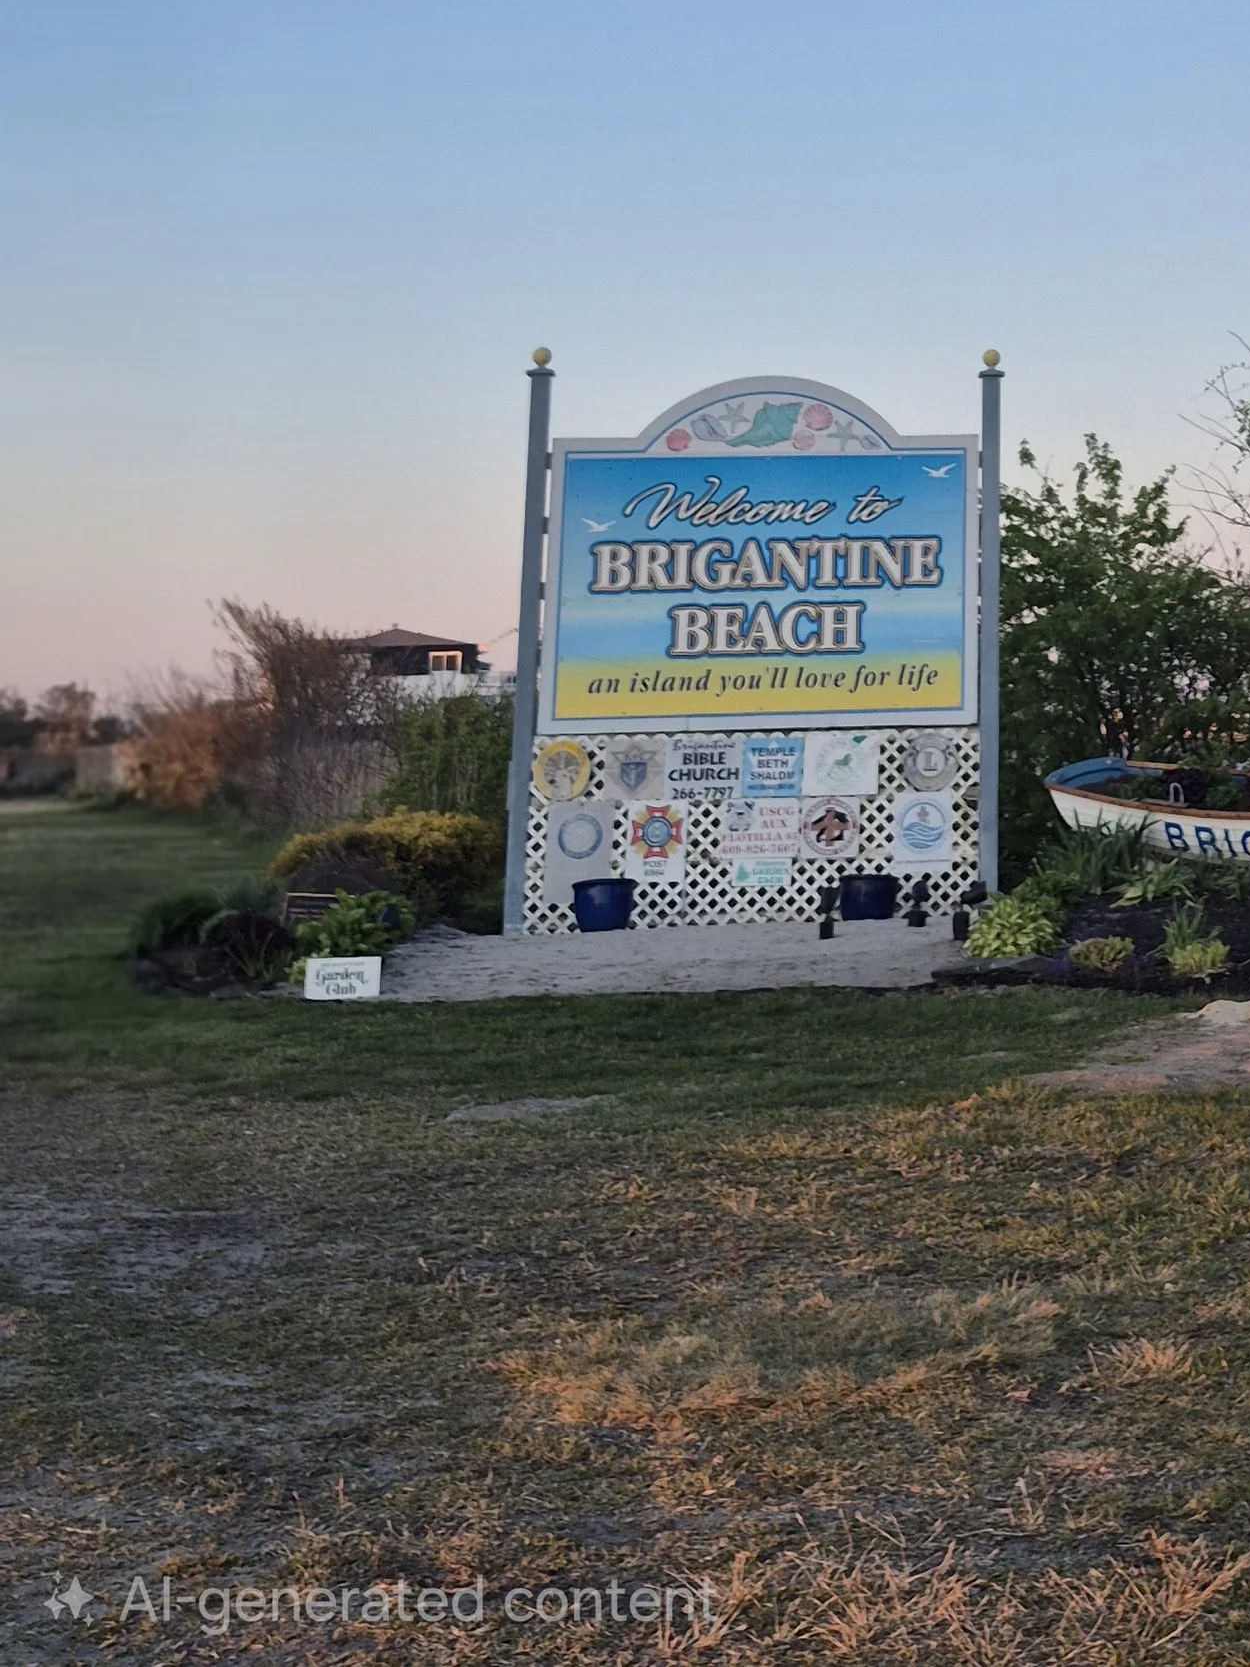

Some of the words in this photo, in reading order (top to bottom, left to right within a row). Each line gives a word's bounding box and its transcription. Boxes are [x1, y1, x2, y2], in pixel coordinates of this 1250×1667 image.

[622, 474, 836, 530] Welcome
[844, 485, 905, 525] to
[589, 537, 943, 592] BRIGANTINE
[666, 602, 865, 657] BEACH
[588, 677, 620, 694] an
[629, 668, 711, 693] island
[714, 666, 787, 698] you'll
[794, 666, 844, 688] love
[848, 664, 889, 694] for
[896, 663, 937, 692] life
[683, 752, 726, 766] BIBLE
[751, 747, 797, 757] TEMPLE
[758, 759, 788, 769] BETH
[668, 768, 739, 781] CHURCH
[672, 786, 735, 800] 266-7797
[759, 806, 794, 816] USCG
